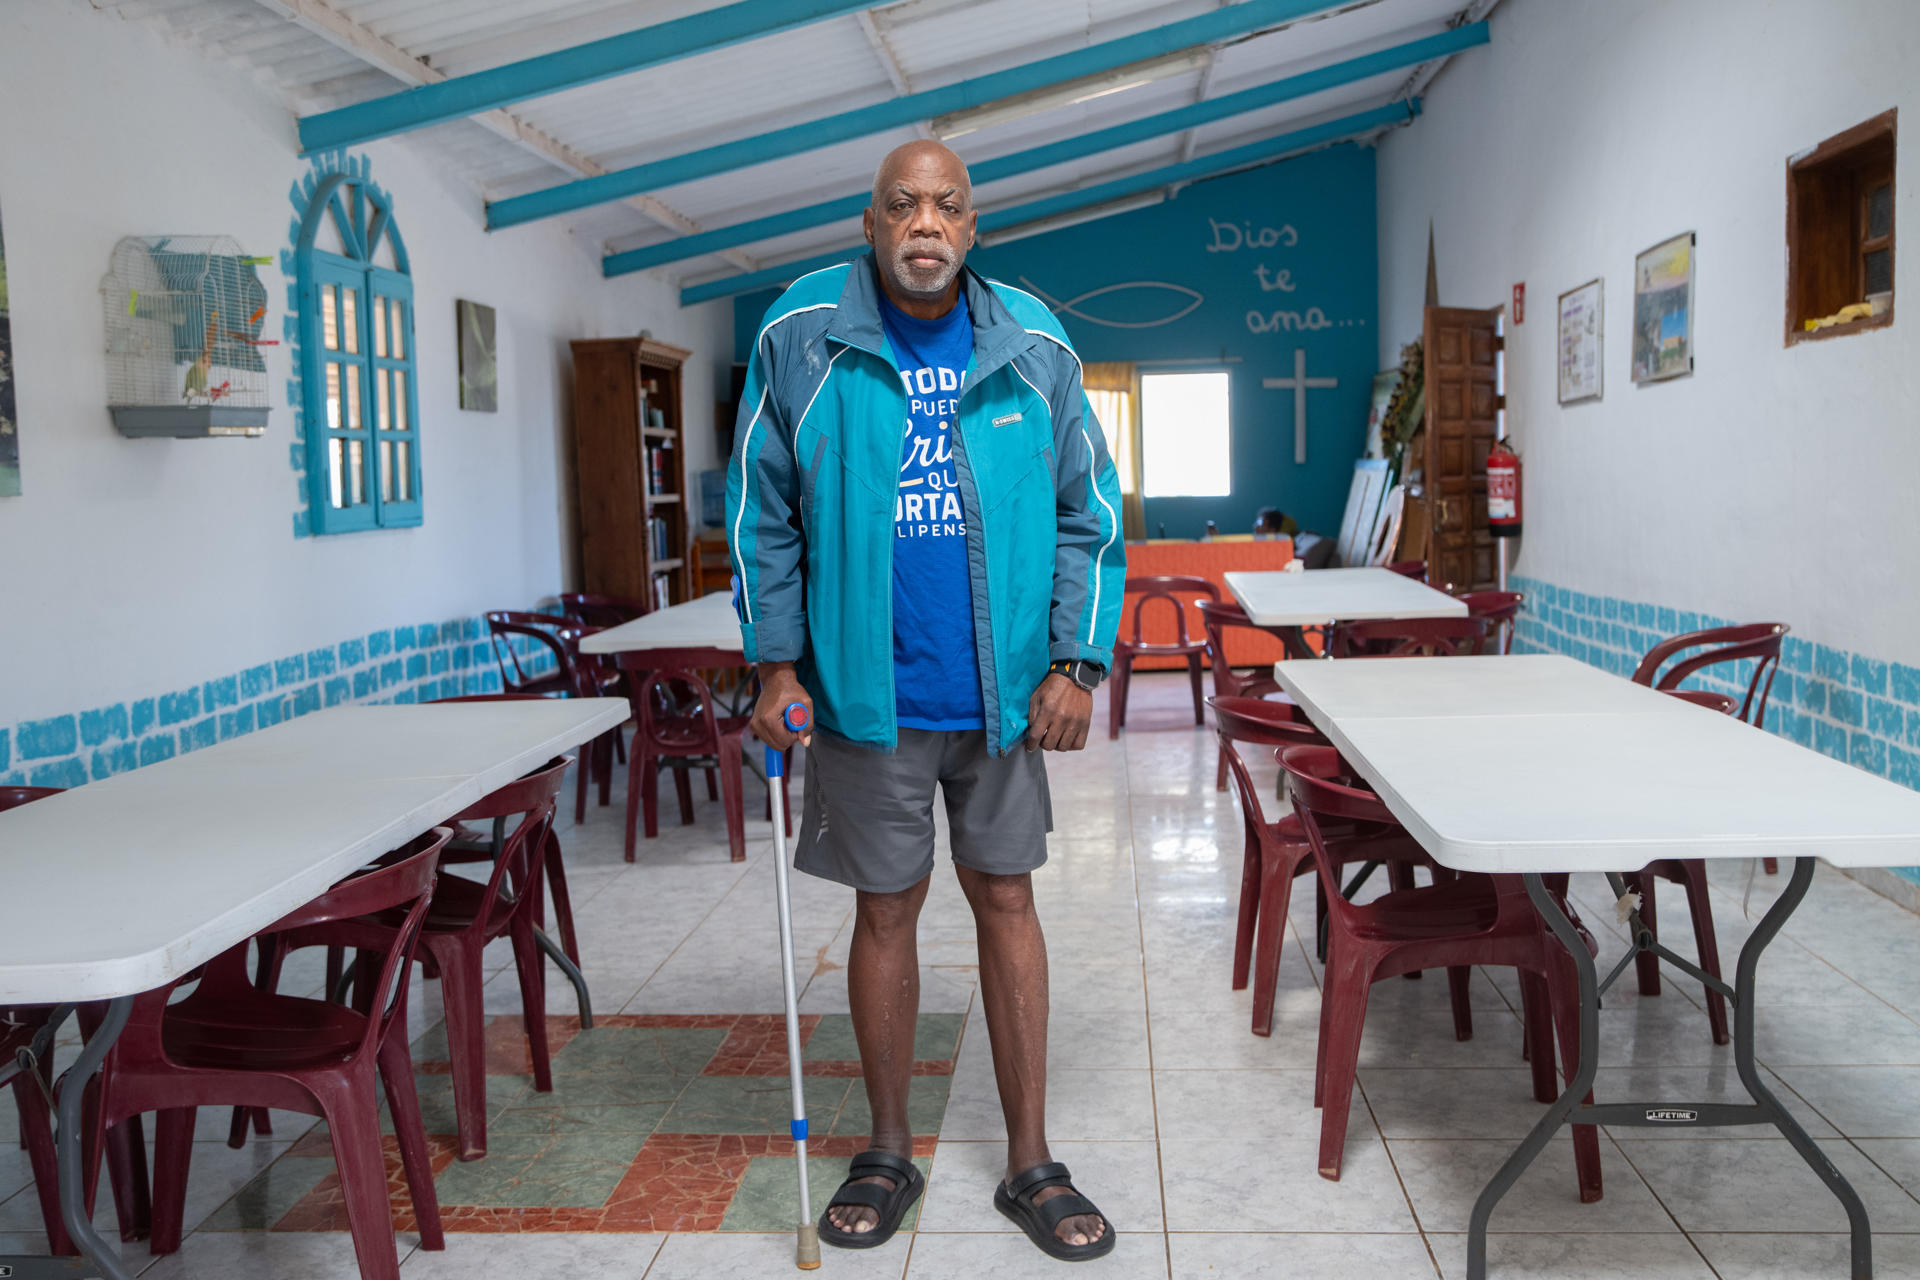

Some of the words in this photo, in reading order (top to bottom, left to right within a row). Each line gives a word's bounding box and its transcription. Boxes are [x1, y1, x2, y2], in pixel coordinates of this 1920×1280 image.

[1206, 217, 1298, 252] Dios
[1253, 263, 1296, 291] te
[900, 367, 966, 396] TOD
[897, 523, 967, 538] LIPENS
[1652, 1111, 1690, 1119] LIFETIME
